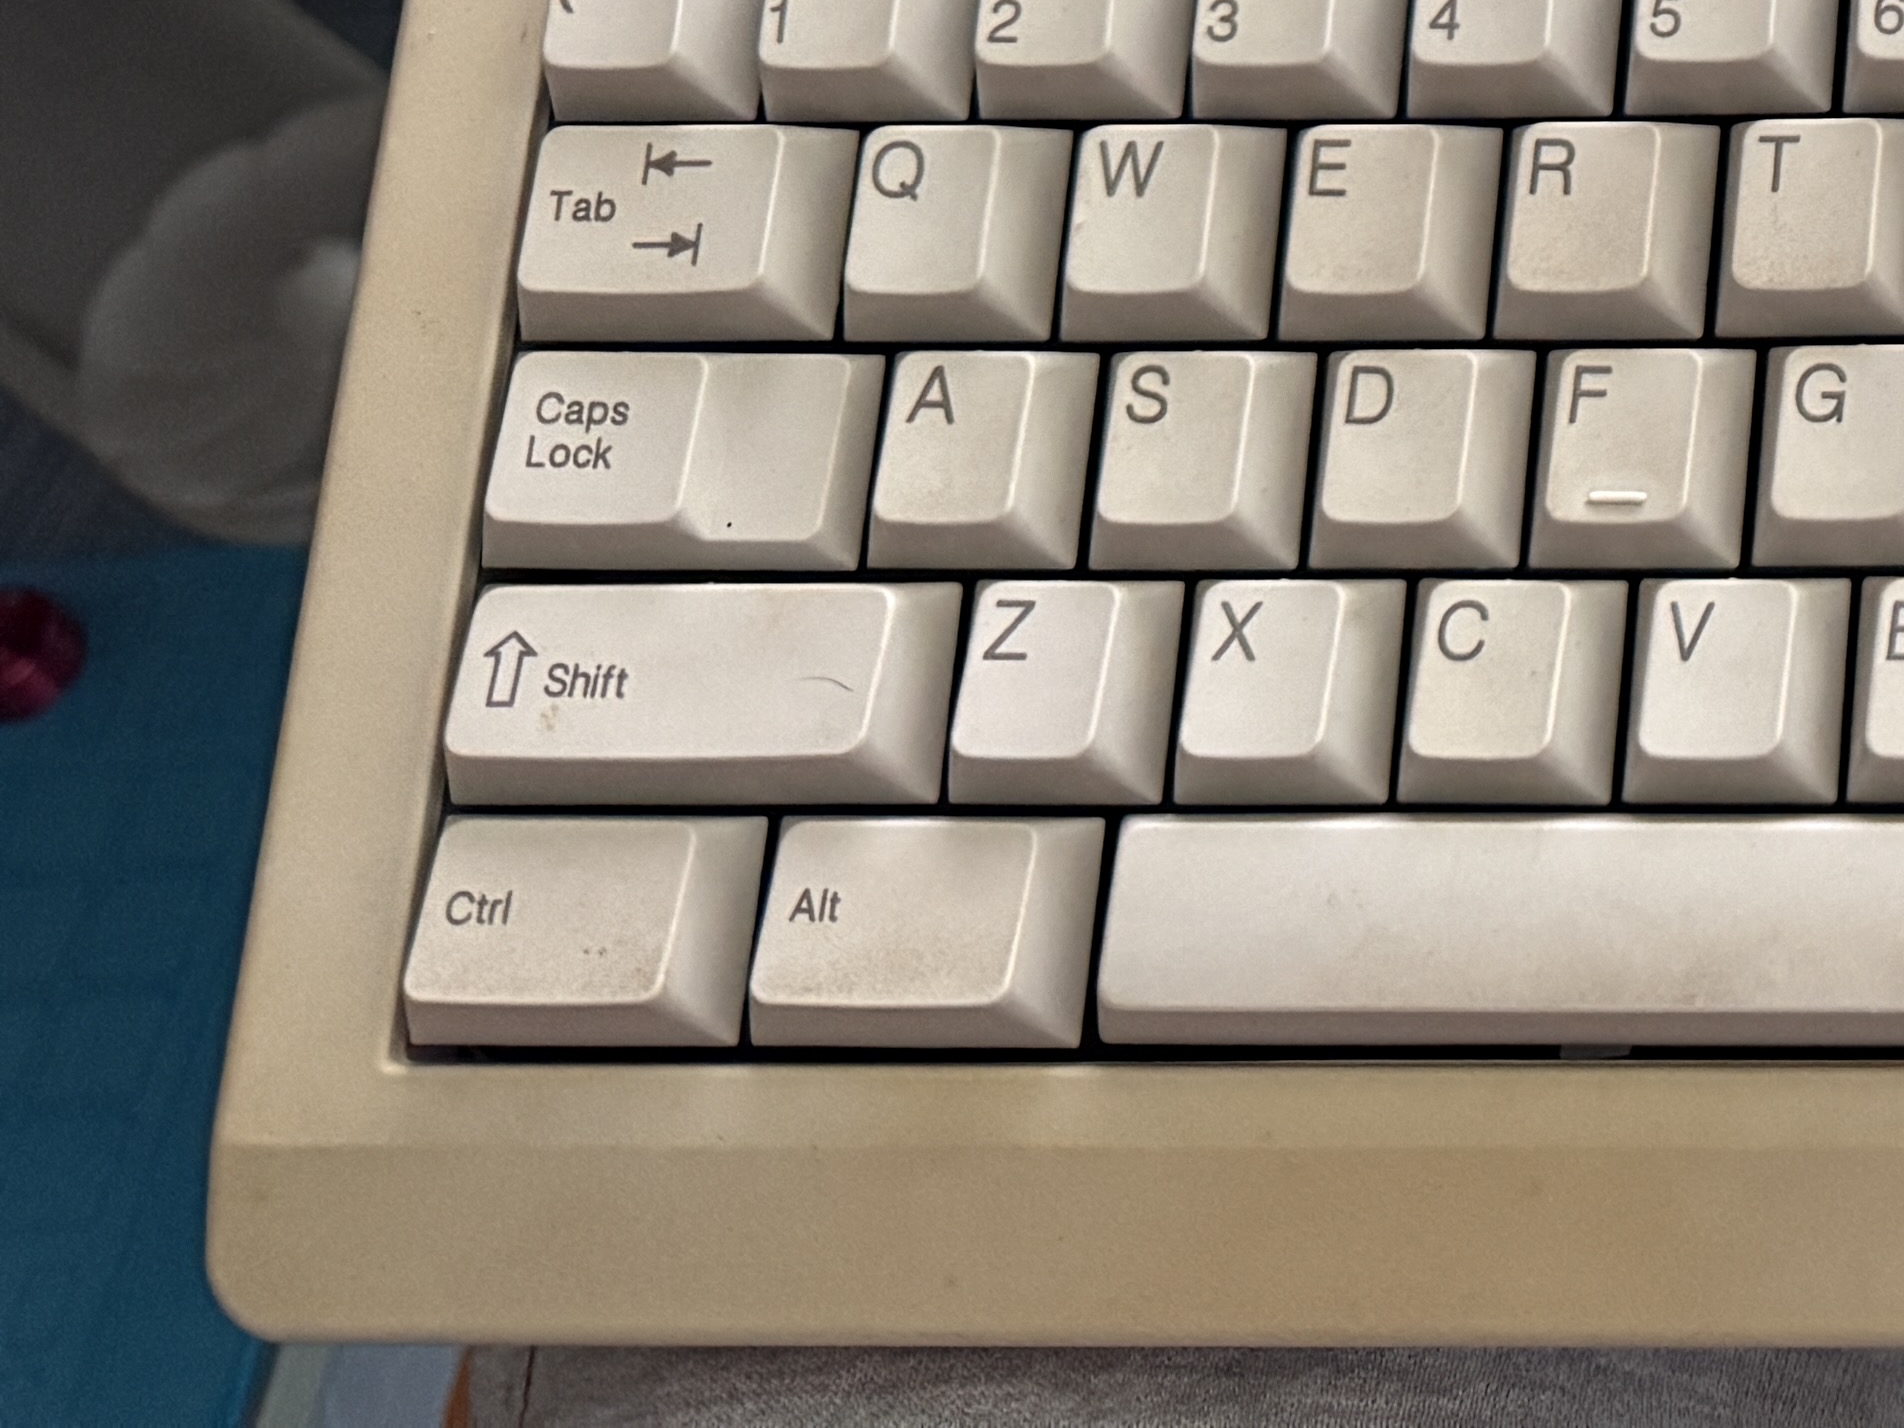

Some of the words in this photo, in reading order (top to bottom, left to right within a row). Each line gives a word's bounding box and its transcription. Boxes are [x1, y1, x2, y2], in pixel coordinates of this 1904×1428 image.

[871, 139, 925, 202] Q
[1098, 139, 1165, 199] W
[1307, 138, 1352, 198] E
[1528, 137, 1576, 196] R
[1757, 134, 1801, 193] T
[549, 189, 617, 223] Tab
[535, 391, 630, 435] Caps
[904, 364, 955, 425] A
[1125, 364, 1171, 425] S
[1343, 365, 1395, 426] D
[1567, 364, 1613, 425] F
[1794, 362, 1847, 424] G
[525, 434, 613, 470] Lock
[982, 599, 1037, 661] Z
[1210, 600, 1264, 662] X
[1436, 599, 1489, 663] C
[1670, 601, 1716, 663] V
[543, 662, 629, 700] Shift
[445, 889, 513, 927] Ctrl
[788, 887, 842, 923] Alt
